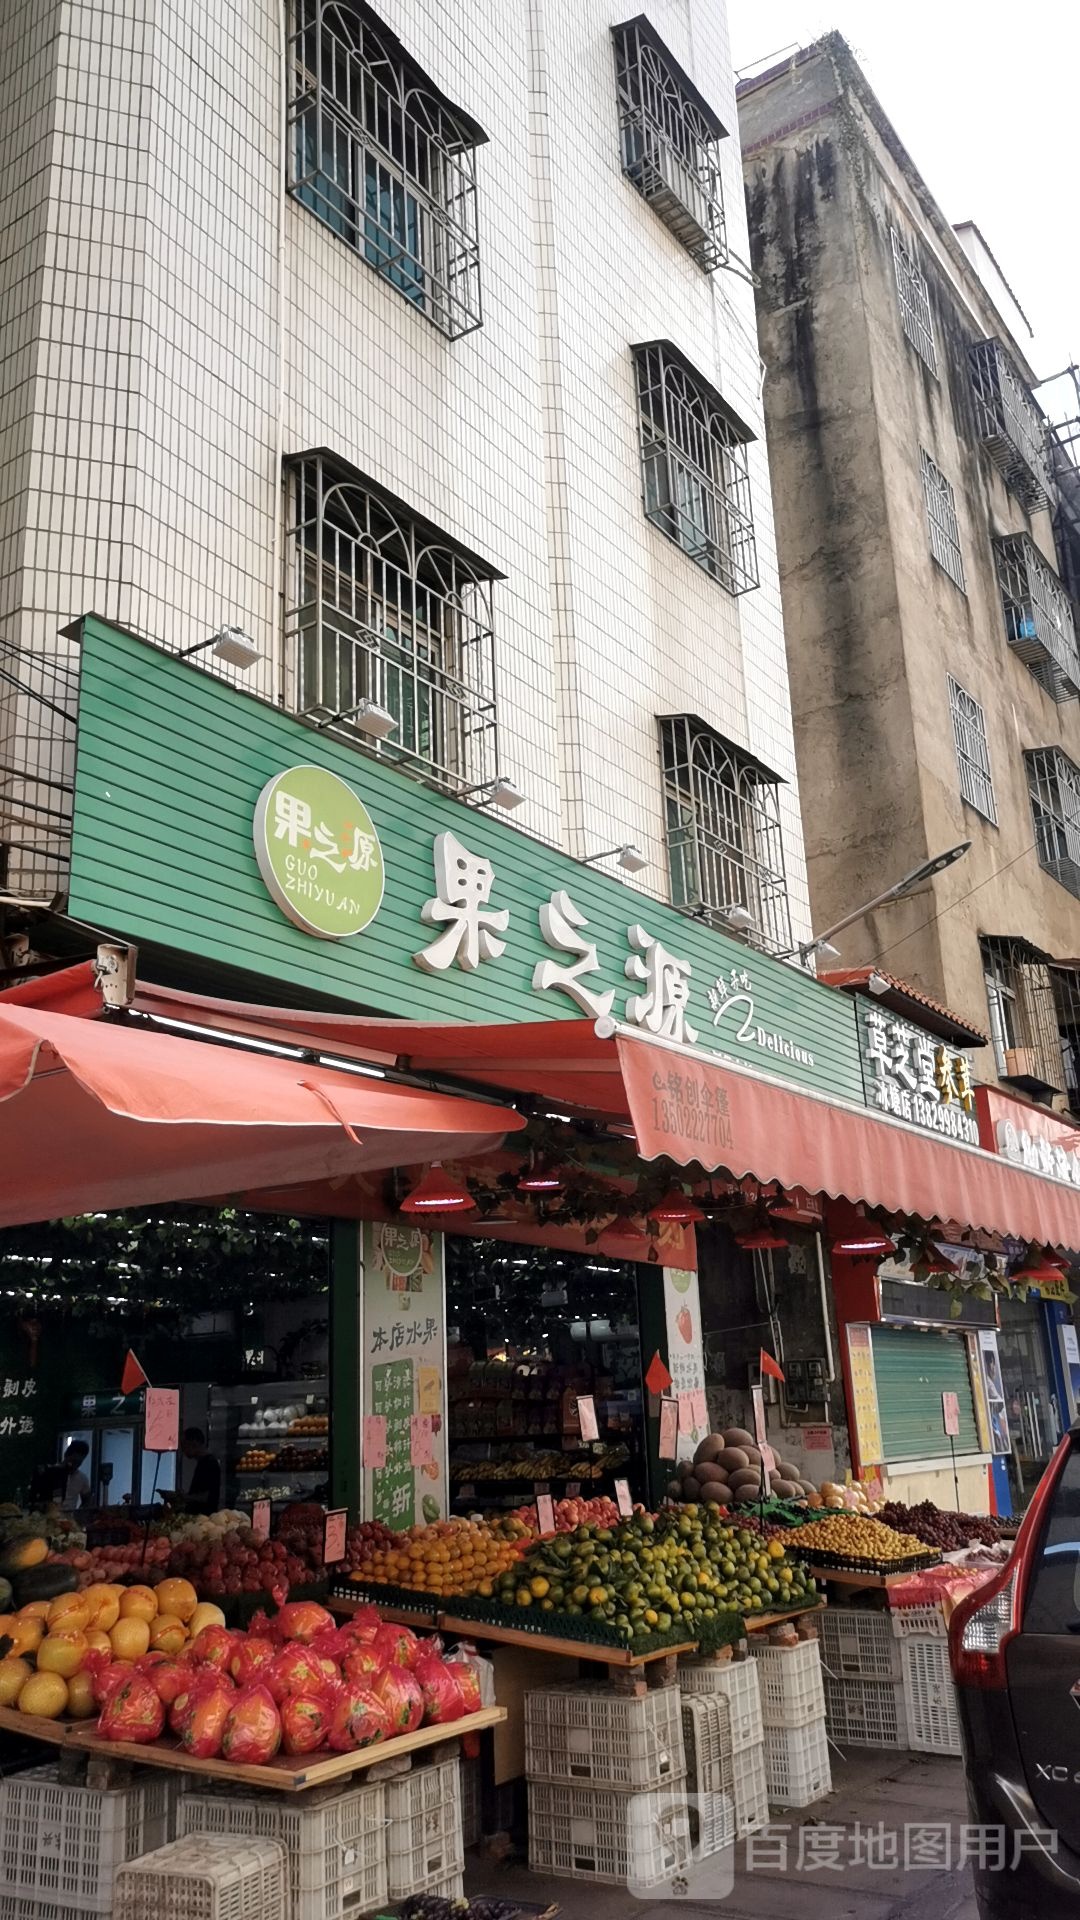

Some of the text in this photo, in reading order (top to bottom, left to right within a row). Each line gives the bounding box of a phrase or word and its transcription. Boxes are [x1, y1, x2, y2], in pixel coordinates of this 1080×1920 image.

[285, 855, 318, 881] GUO
[285, 874, 360, 915] ZHIYUAN
[411, 831, 699, 1043] 果之源
[757, 1025, 815, 1067] Delicious
[652, 1097, 734, 1150] 13502227704
[914, 1094, 980, 1147] 13829984310
[371, 1317, 438, 1353] 本店水果
[2, 1377, 37, 1398] 剥皮
